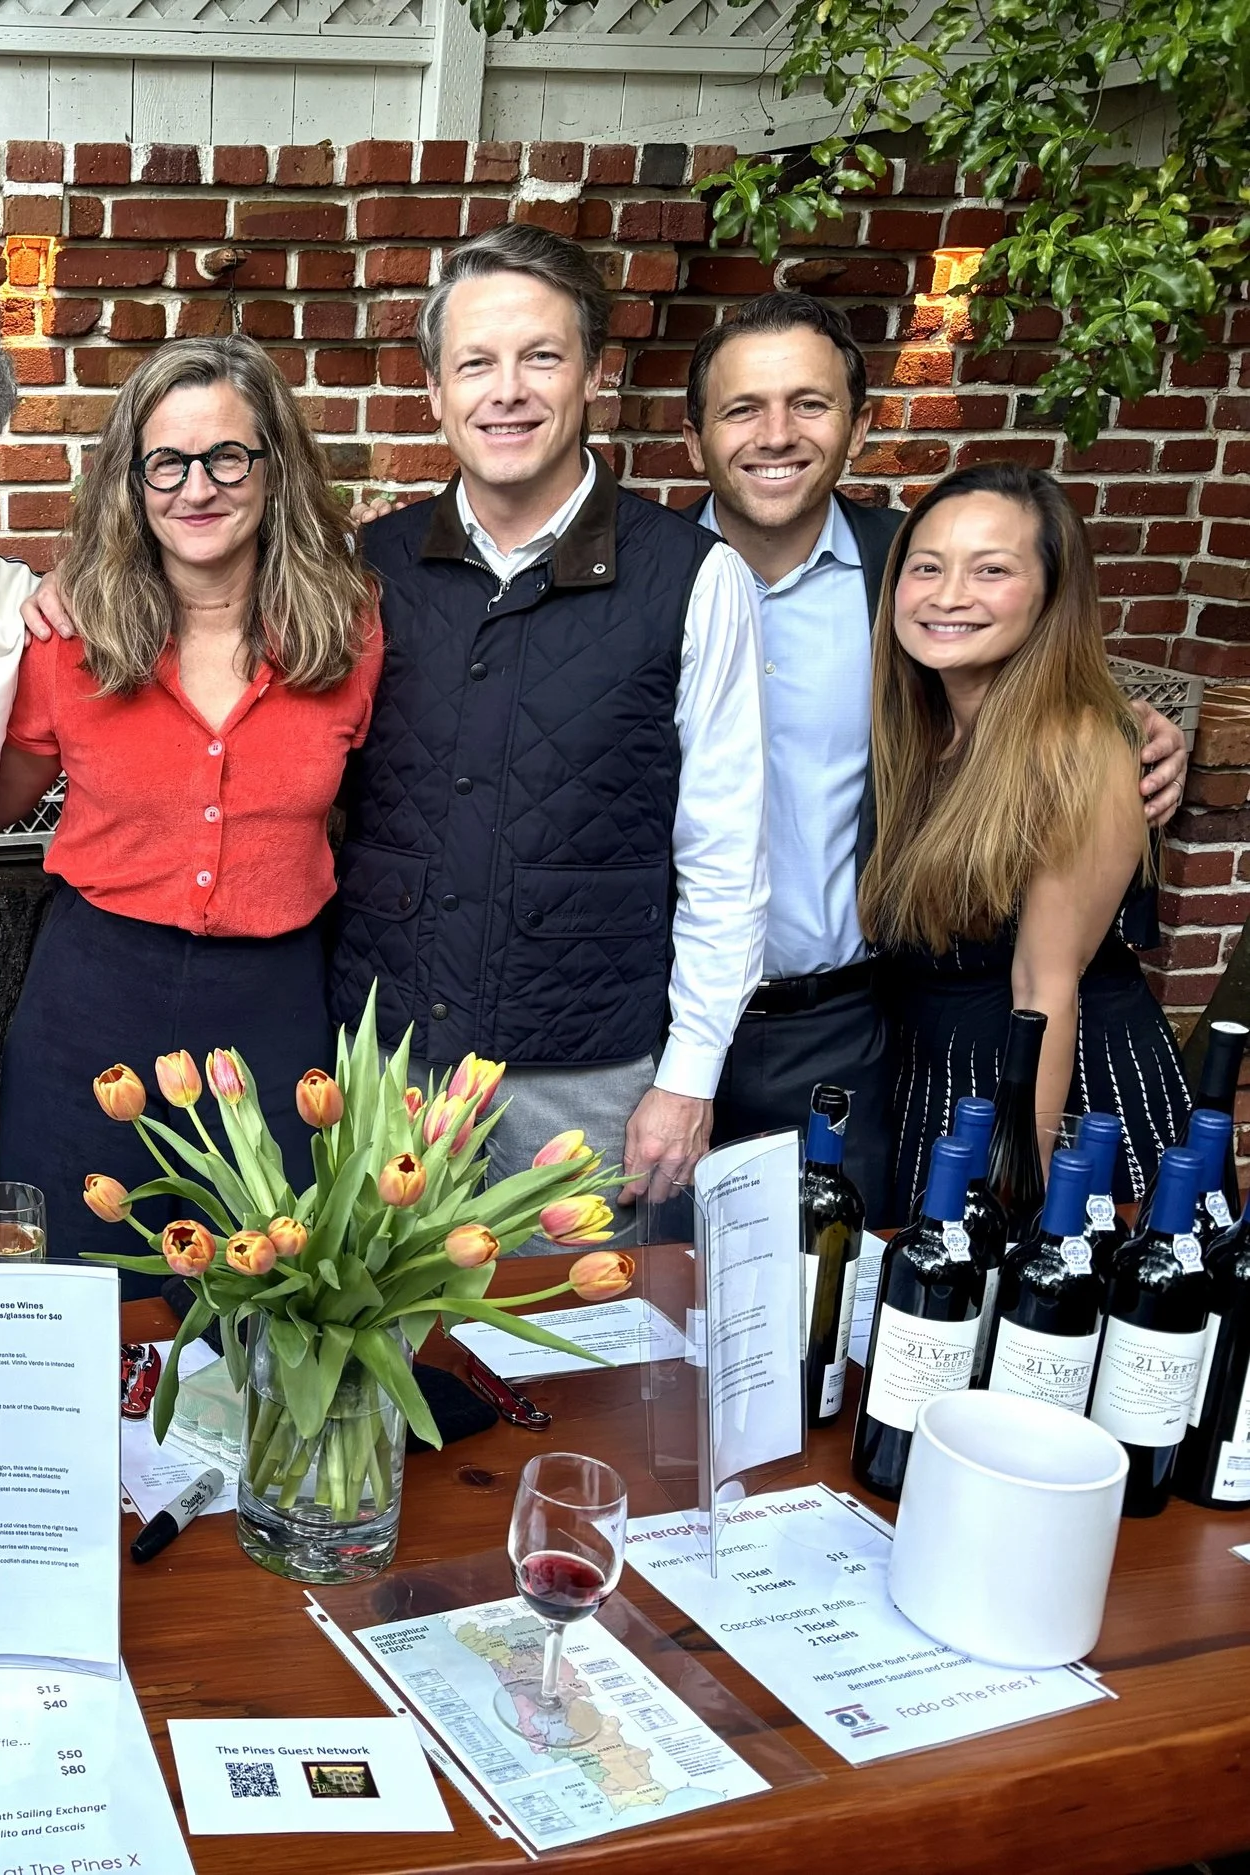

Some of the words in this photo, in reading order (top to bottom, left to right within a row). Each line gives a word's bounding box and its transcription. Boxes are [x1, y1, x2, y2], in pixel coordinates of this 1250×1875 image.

[16, 1301, 44, 1310] Wines
[48, 1312, 62, 1320] $40
[935, 1358, 968, 1368] DOURO
[1054, 1373, 1087, 1383] DOURO
[764, 1499, 822, 1515] Tickets
[648, 1556, 683, 1569] Wines
[683, 1554, 693, 1563] in
[736, 1567, 773, 1580] Ticket
[825, 1551, 849, 1562] $15
[746, 1586, 757, 1594] 3
[754, 1579, 796, 1592] Tickets
[843, 1563, 866, 1574] $40
[719, 1617, 767, 1632] Cascais
[764, 1606, 820, 1623] Vacation
[793, 1625, 803, 1634] 1
[801, 1618, 839, 1632] Ticket
[370, 1625, 429, 1642] Geographical
[375, 1633, 426, 1649] Indications
[807, 1637, 819, 1646] 2
[817, 1630, 859, 1644] Tickets
[388, 1644, 414, 1654] DOCs
[812, 1671, 834, 1683] Help
[833, 1665, 868, 1679] Support
[867, 1661, 883, 1670] the
[882, 1655, 908, 1666] Youth
[906, 1649, 934, 1661] Sailing
[847, 1677, 886, 1691] Between
[884, 1668, 924, 1683] Sausalito
[923, 1664, 941, 1673] and
[940, 1657, 972, 1669] Cascais
[36, 1684, 61, 1695] $15
[895, 1700, 940, 1719] Fado
[940, 1695, 959, 1708] at
[954, 1688, 988, 1704] The
[985, 1679, 1028, 1697] Pines
[1024, 1674, 1042, 1686] X
[42, 1699, 67, 1710] $40
[57, 1749, 83, 1760] $50
[215, 1745, 239, 1754] The
[242, 1745, 275, 1755] Pines
[277, 1746, 314, 1755] Guest
[316, 1745, 370, 1755] Network
[60, 1764, 86, 1776] $80
[16, 1807, 53, 1820] Sailing
[55, 1803, 107, 1818] Exchange
[21, 1826, 42, 1836] and
[45, 1822, 86, 1834] Cascais
[29, 1863, 65, 1875] The
[71, 1855, 122, 1874] Pines
[126, 1853, 141, 1867] X
